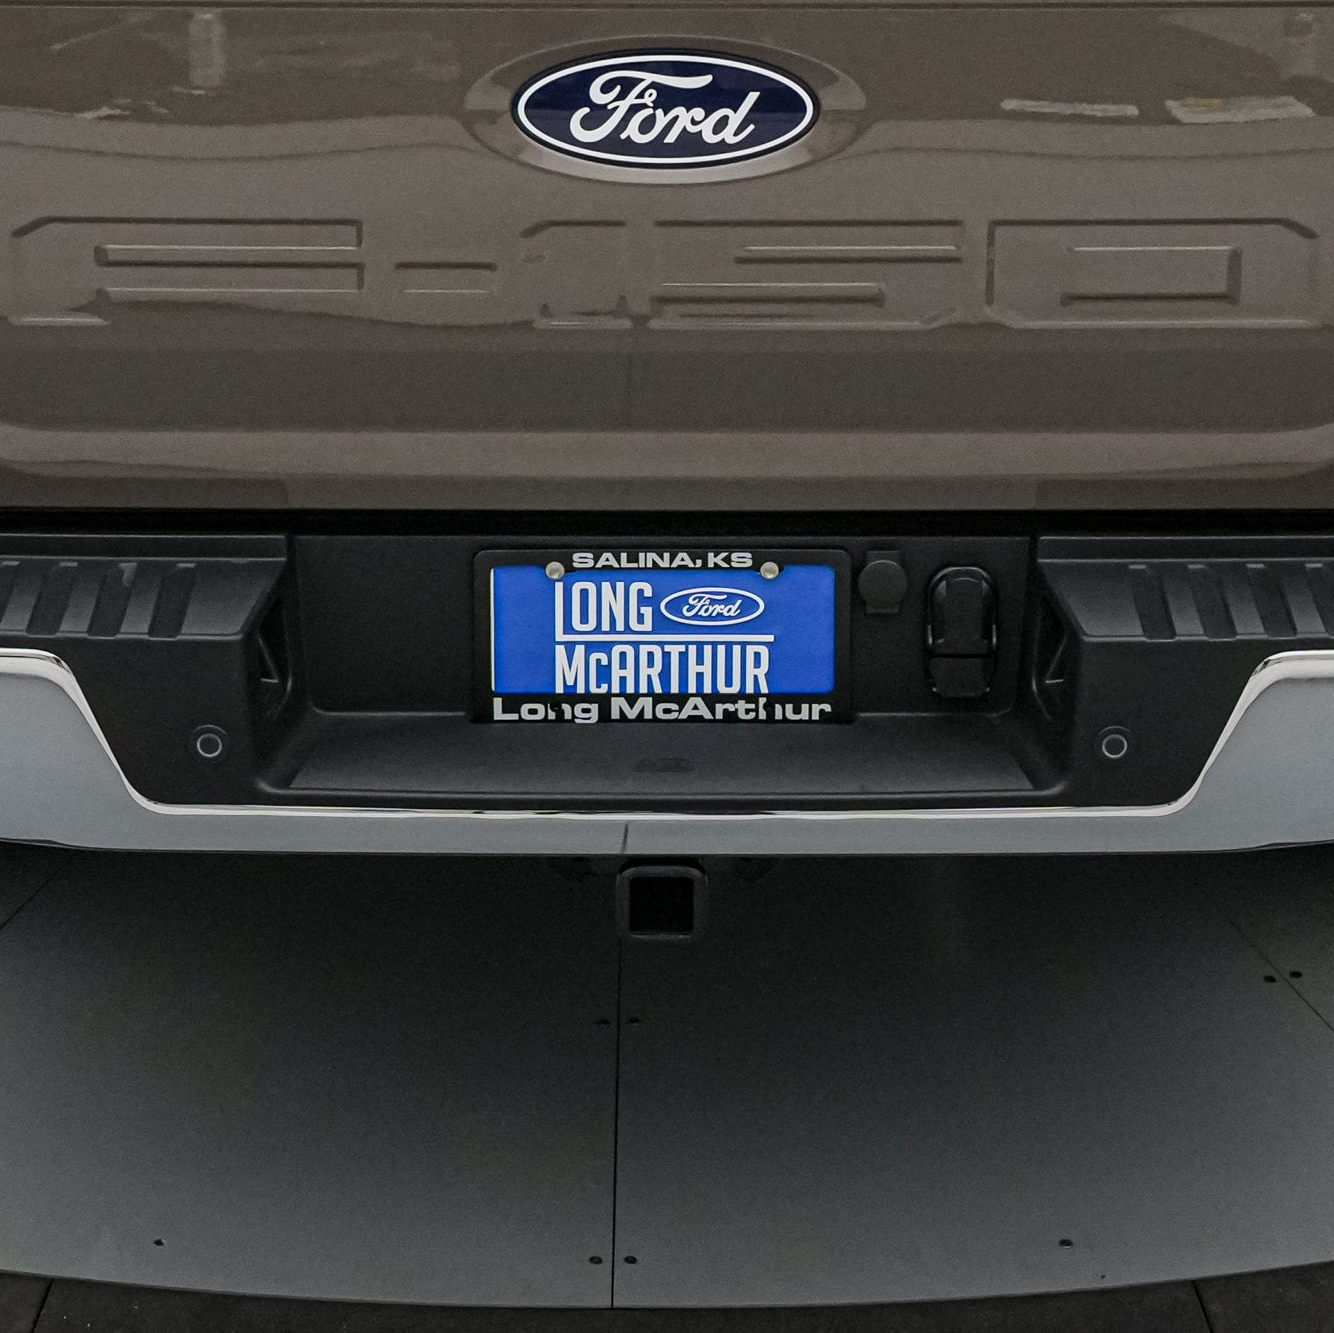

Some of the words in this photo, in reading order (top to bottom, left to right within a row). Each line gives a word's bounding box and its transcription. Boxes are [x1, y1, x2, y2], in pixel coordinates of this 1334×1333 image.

[569, 70, 761, 144] Ford
[571, 552, 703, 568] SALINA,
[707, 552, 753, 568] KS
[555, 581, 653, 640] LONG
[682, 593, 742, 618] Ford
[555, 644, 769, 694] McARTHUR
[493, 697, 599, 723] Long
[611, 697, 832, 721] McArthur
